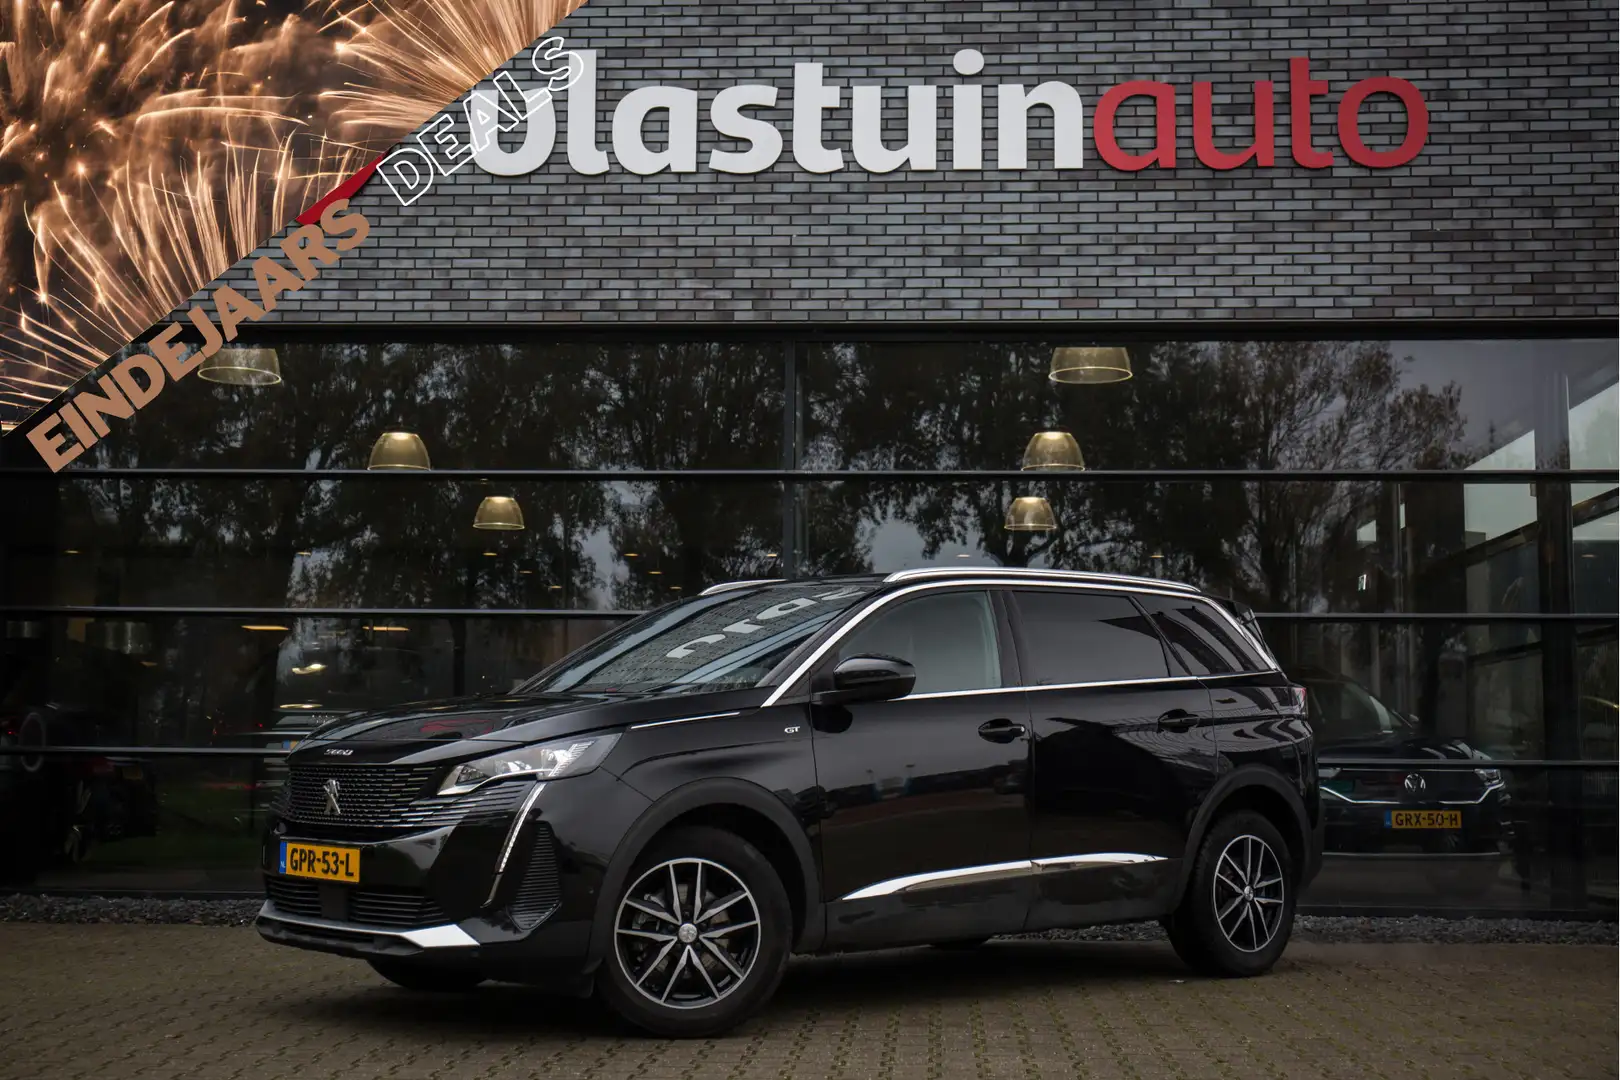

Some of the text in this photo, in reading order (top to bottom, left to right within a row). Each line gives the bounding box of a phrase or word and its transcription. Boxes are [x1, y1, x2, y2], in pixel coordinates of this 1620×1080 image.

[784, 725, 801, 734] GT
[1395, 812, 1459, 827] GRX-50-H
[290, 847, 355, 877] GPR-53-L
